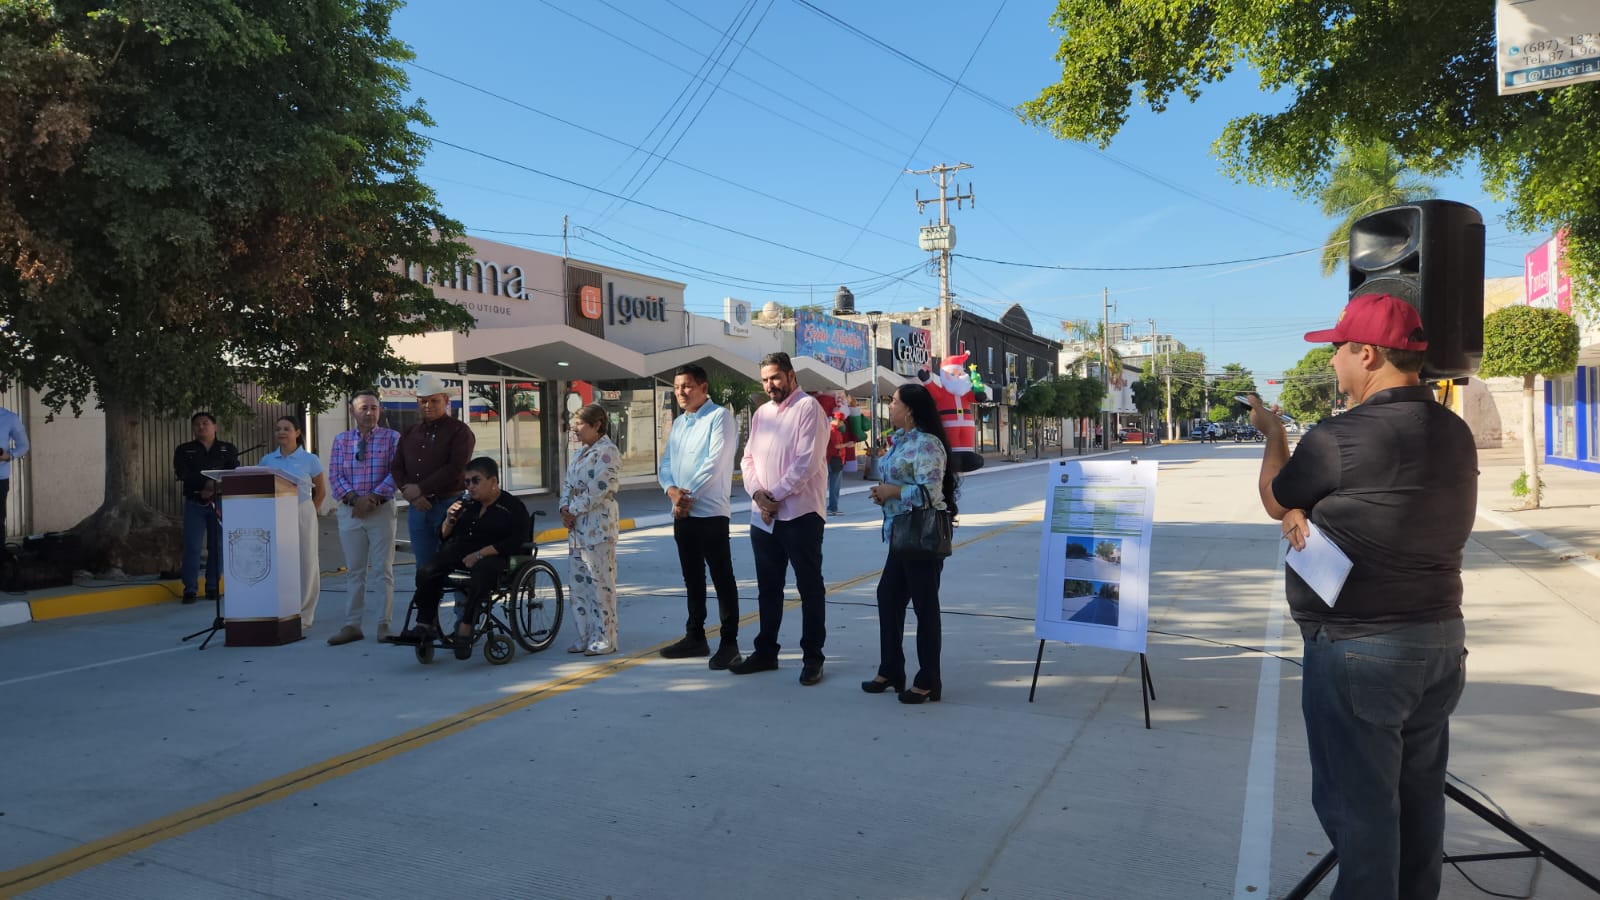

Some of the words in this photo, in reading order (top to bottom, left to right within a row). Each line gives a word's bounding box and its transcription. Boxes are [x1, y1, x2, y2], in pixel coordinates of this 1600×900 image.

[1523, 40, 1559, 55] (687)
[1522, 54, 1545, 66] Tel.
[911, 331, 929, 348] CASA
